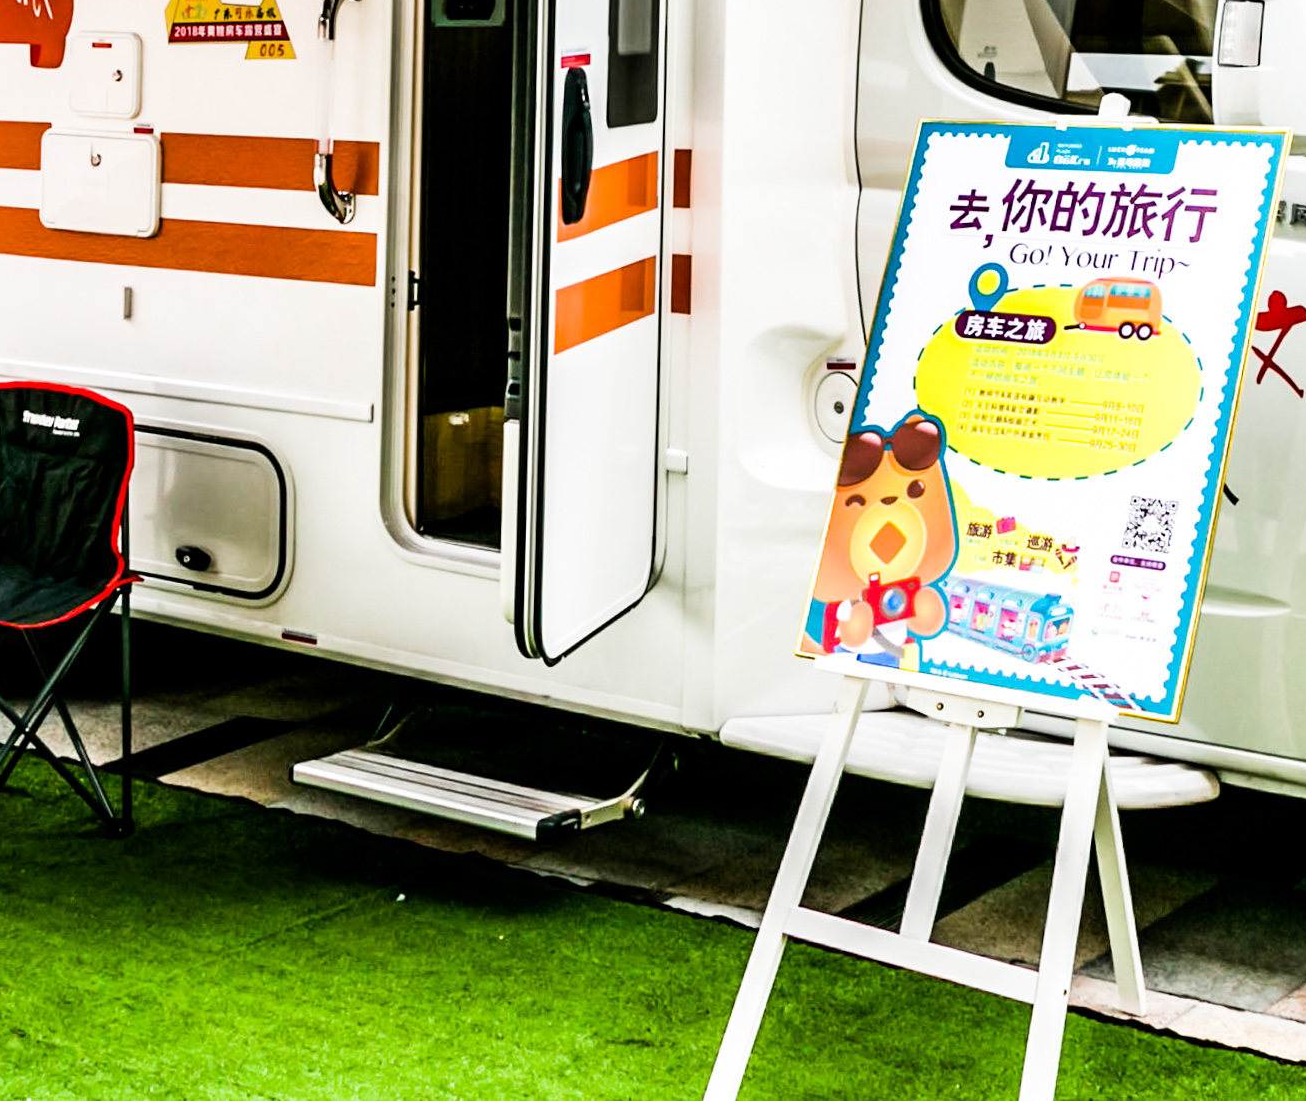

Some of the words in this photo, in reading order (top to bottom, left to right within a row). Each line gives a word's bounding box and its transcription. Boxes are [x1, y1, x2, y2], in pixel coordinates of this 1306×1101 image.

[259, 43, 285, 57] 005
[1009, 243, 1053, 267] Go!
[1062, 245, 1119, 271] Your
[964, 315, 1048, 342] 房车之旅
[966, 521, 993, 539] 旅游
[1026, 533, 1054, 553] 巡游
[991, 549, 1017, 568] 市集
